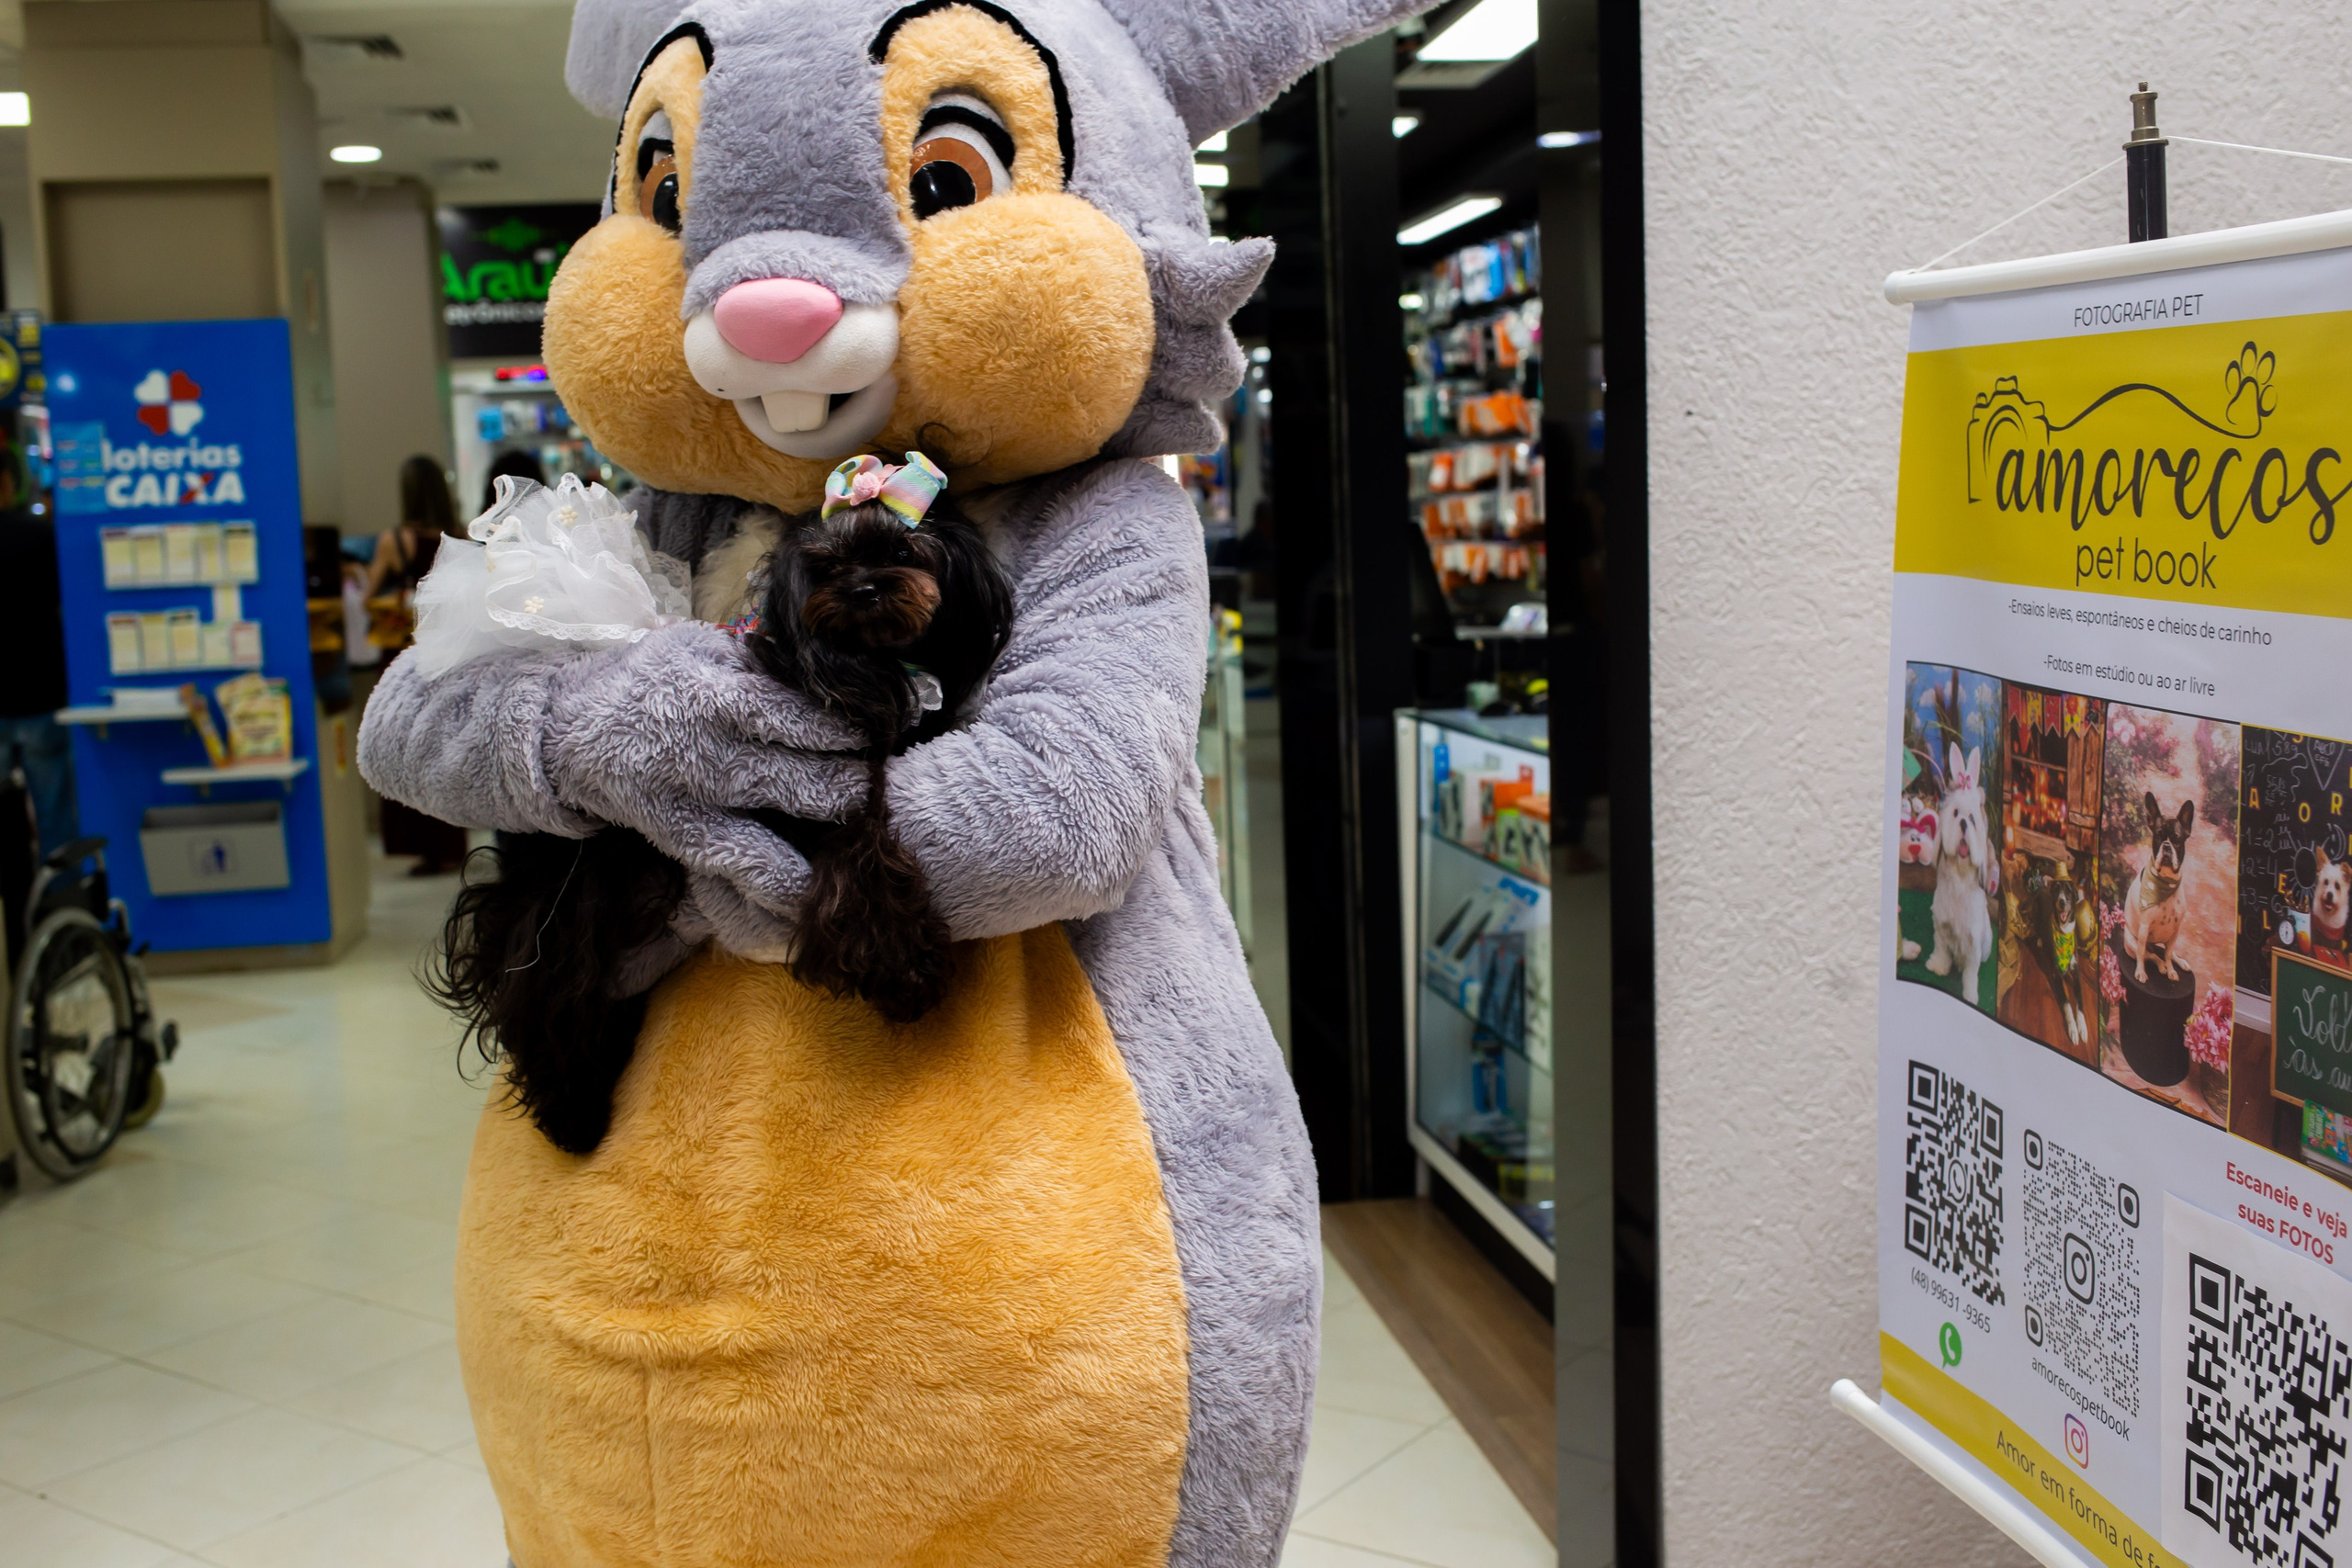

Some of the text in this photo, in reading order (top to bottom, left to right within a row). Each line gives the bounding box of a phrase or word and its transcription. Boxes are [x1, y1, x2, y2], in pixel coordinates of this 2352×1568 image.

[440, 250, 560, 302] Arau
[2074, 293, 2204, 328] FOTOGRAFIA PET
[102, 436, 242, 472] loterias
[105, 470, 245, 508] CAIXA
[1996, 446, 2352, 546] amorecos
[2075, 536, 2217, 589] pet book
[2008, 598, 2273, 646] -Ensaios leves, espontâneos e cheios de carinho
[2043, 654, 2216, 697] -Fotos em estúdio ou ao ar livre
[2249, 787, 2260, 809] A
[2298, 802, 2311, 823] O
[2330, 792, 2344, 816] R
[2278, 873, 2288, 894] E
[2263, 908, 2271, 930] L
[2326, 1066, 2352, 1092] au
[2226, 1160, 2347, 1239] Escaneie e veja
[2237, 1203, 2334, 1265] suas FOTOS
[1911, 1267, 1991, 1334] (48) 99631 -9365
[2031, 1357, 2131, 1442] amorecospetbook
[1996, 1430, 2143, 1568] Amor em forma de
